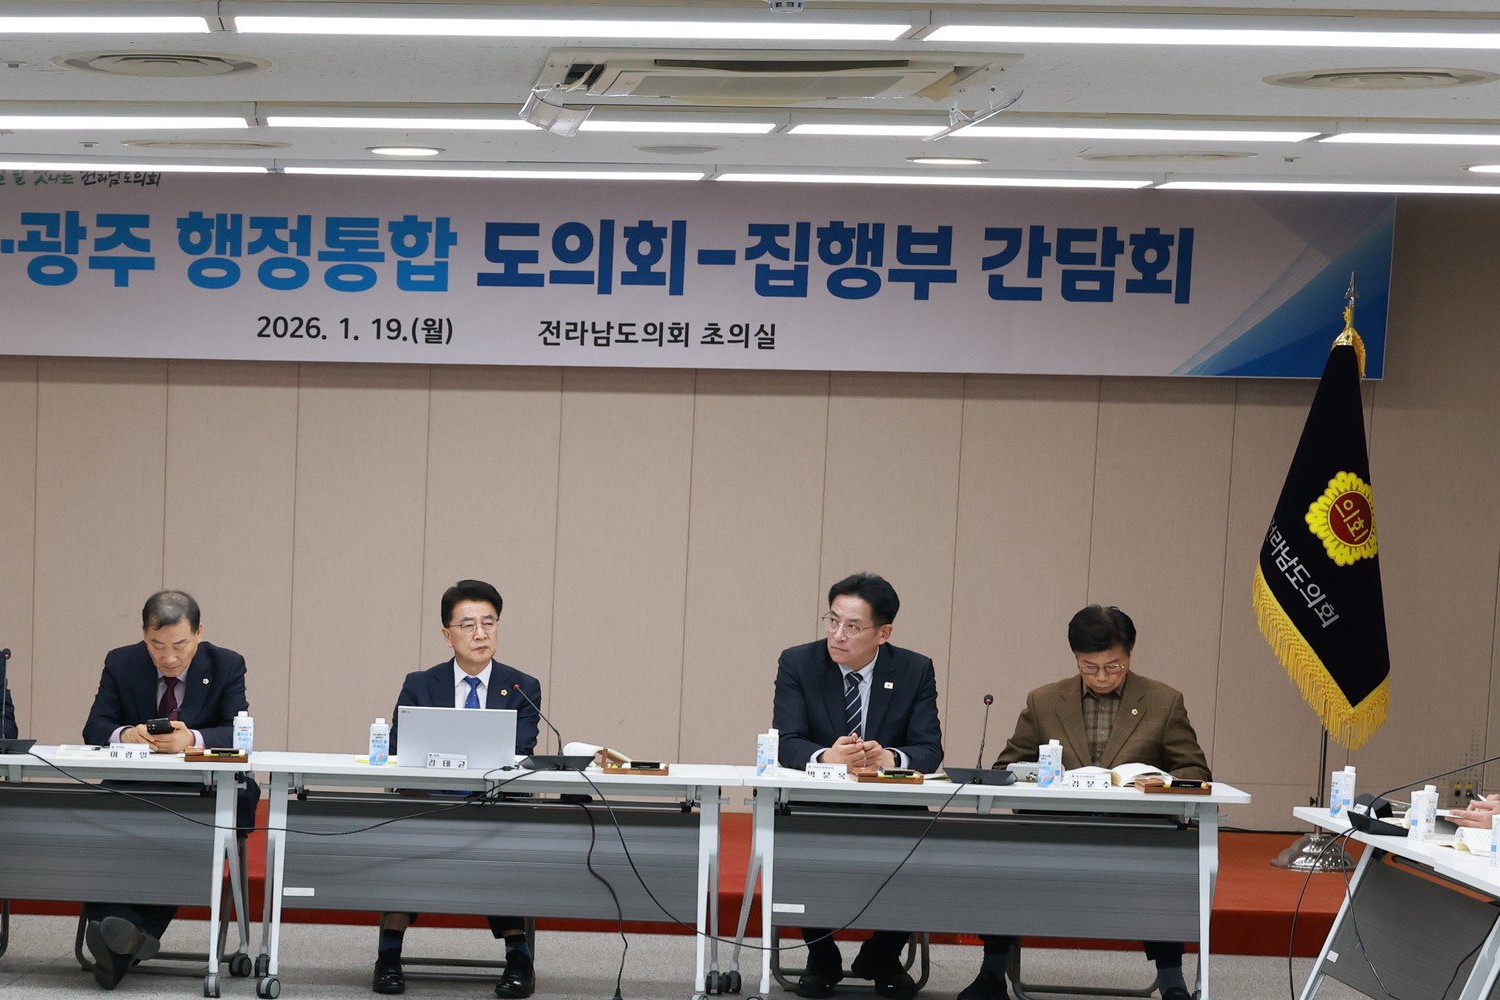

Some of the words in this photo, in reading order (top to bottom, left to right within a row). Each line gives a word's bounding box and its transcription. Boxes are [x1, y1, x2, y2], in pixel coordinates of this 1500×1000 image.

[177, 211, 457, 292] 행정통합
[982, 224, 1194, 304] 간담회
[257, 316, 327, 341] 2026.
[340, 317, 359, 341] 1.
[372, 317, 453, 346] 19.(월)
[538, 321, 690, 348] 전라남도의회
[701, 323, 776, 350] 초의실
[1334, 499, 1369, 542] 의회
